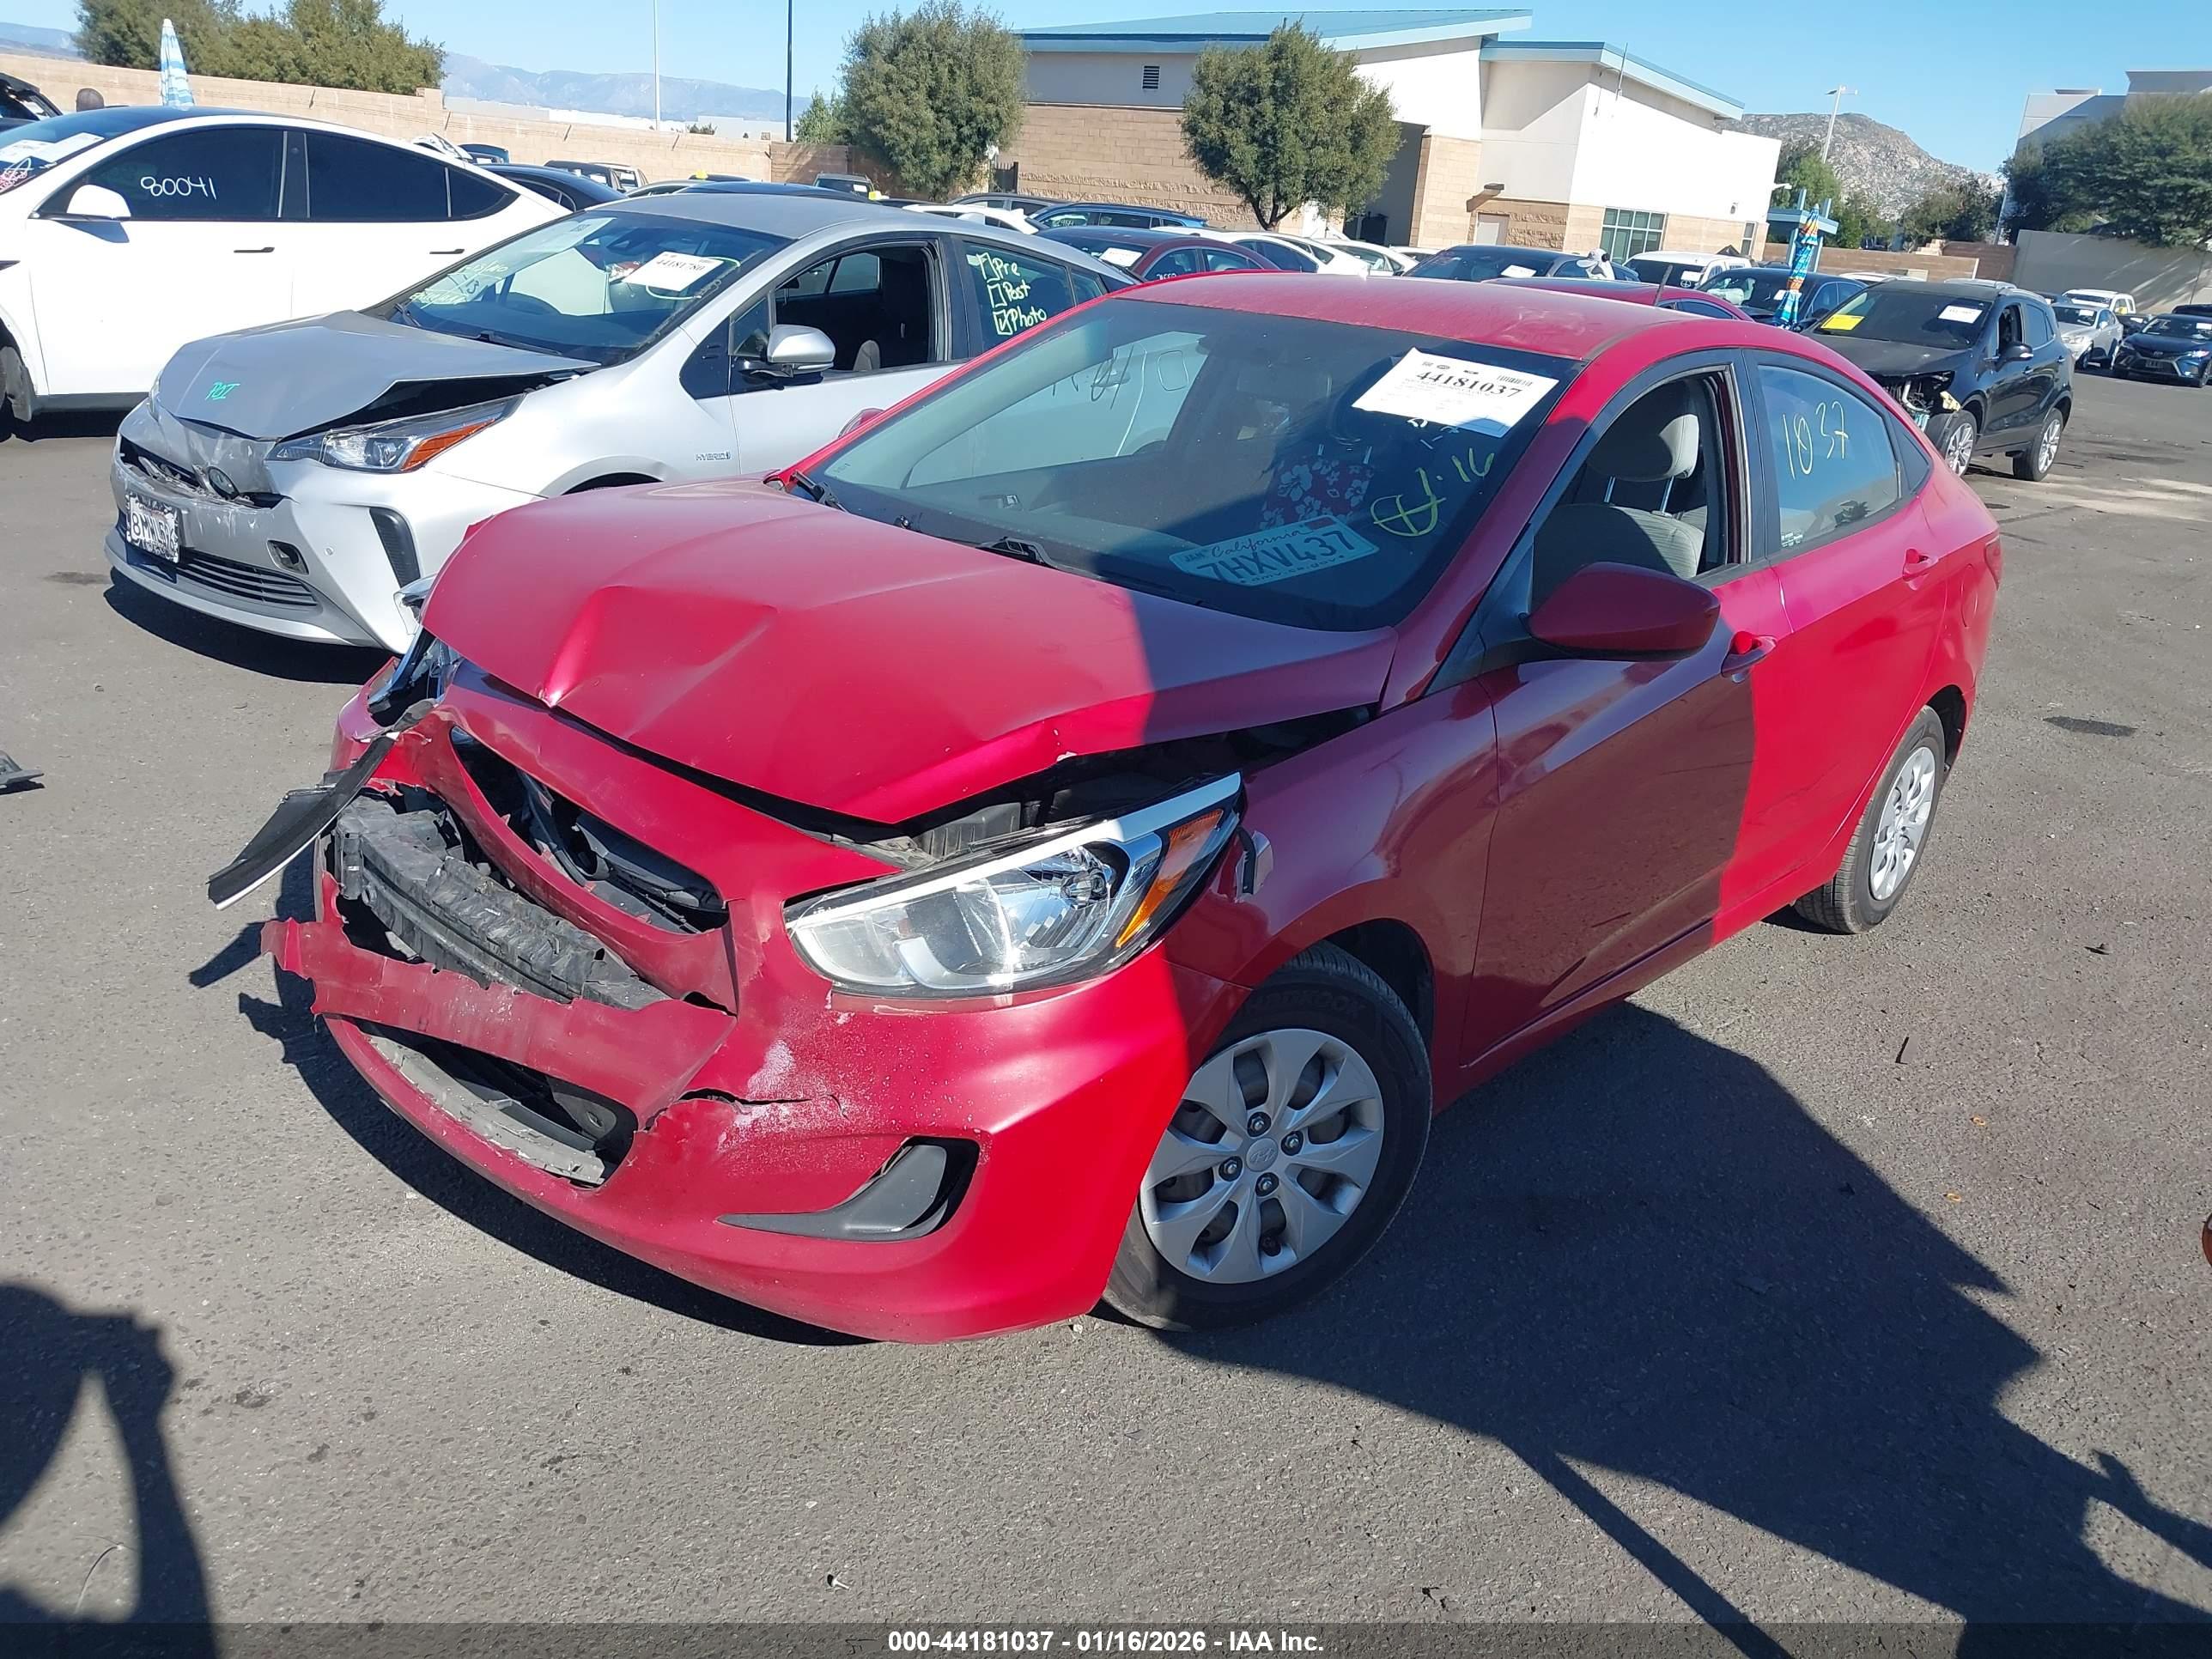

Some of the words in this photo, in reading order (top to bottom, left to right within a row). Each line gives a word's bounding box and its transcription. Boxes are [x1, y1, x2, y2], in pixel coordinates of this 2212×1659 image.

[140, 176, 217, 199] 80041
[992, 257, 1021, 280] Pre
[1003, 280, 1031, 302] Post
[1006, 307, 1048, 331] Photo
[1417, 371, 1522, 398] 44181037
[1212, 529, 1314, 558] California
[1196, 530, 1355, 583] 7HXV437
